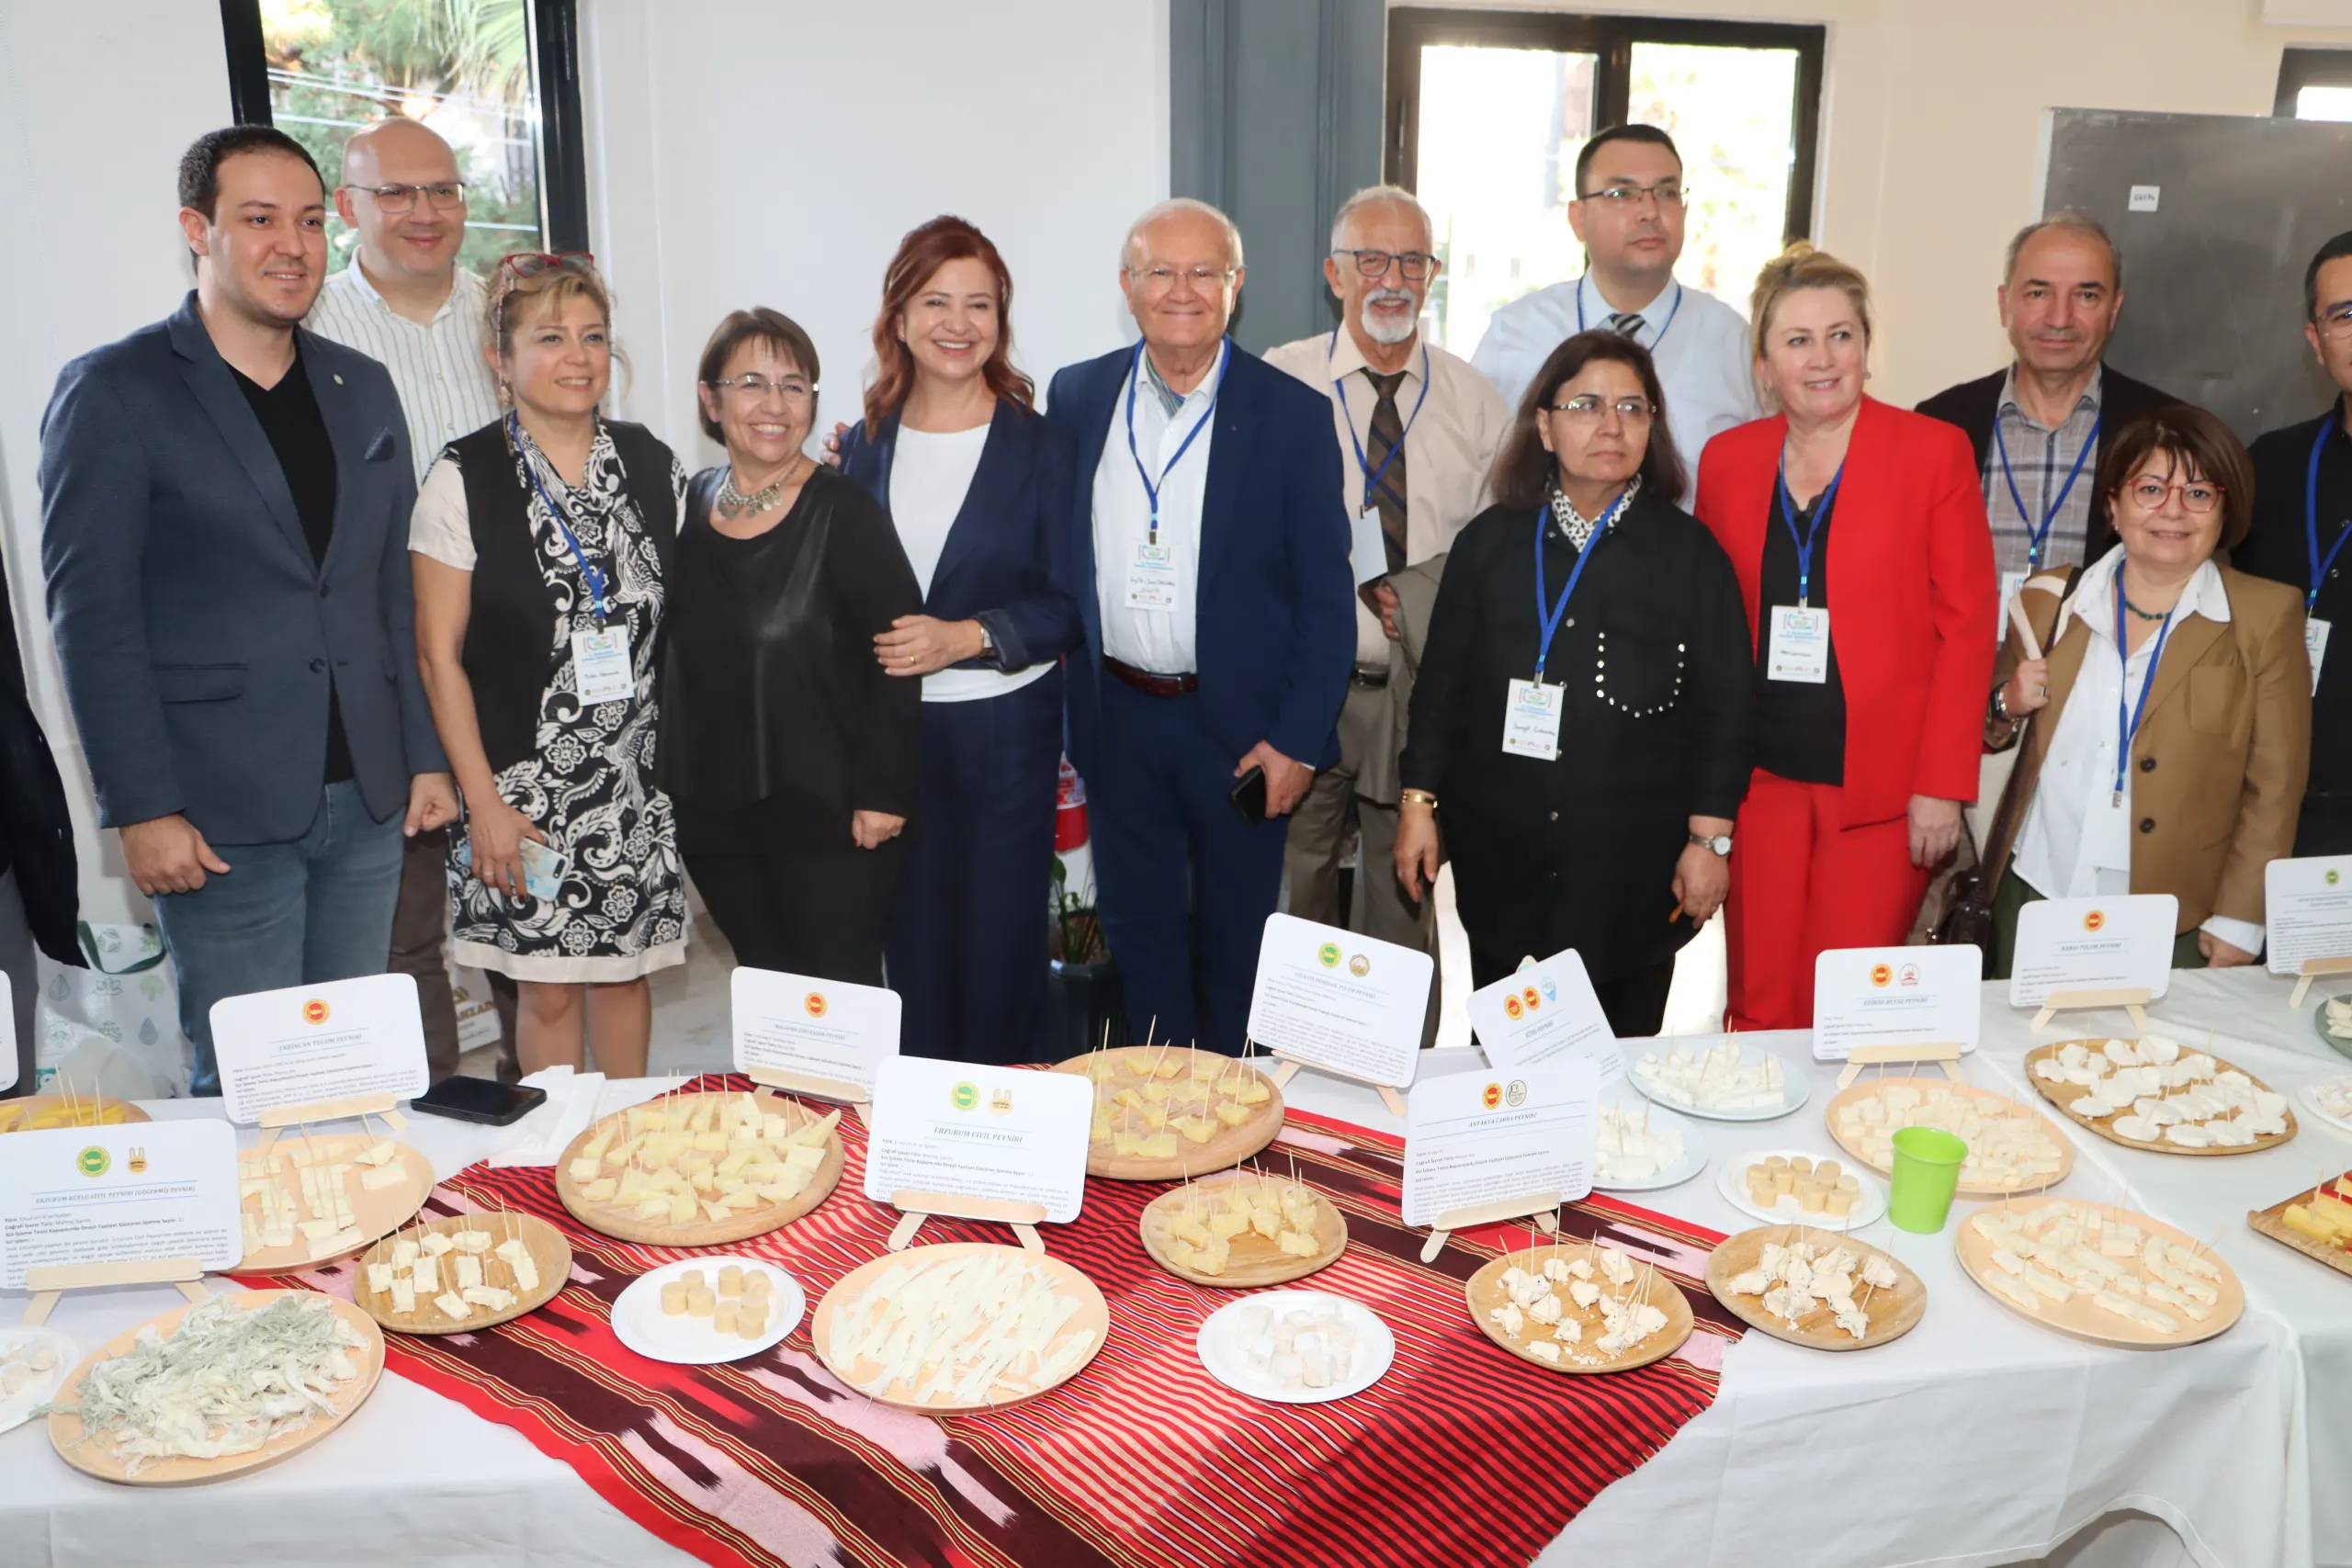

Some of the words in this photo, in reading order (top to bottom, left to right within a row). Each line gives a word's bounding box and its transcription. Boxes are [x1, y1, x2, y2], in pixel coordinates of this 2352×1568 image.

[934, 1127, 970, 1137] ERZURUM
[992, 1134, 1023, 1143] PEYNİRİ
[36, 1195, 68, 1203] ERZURUM
